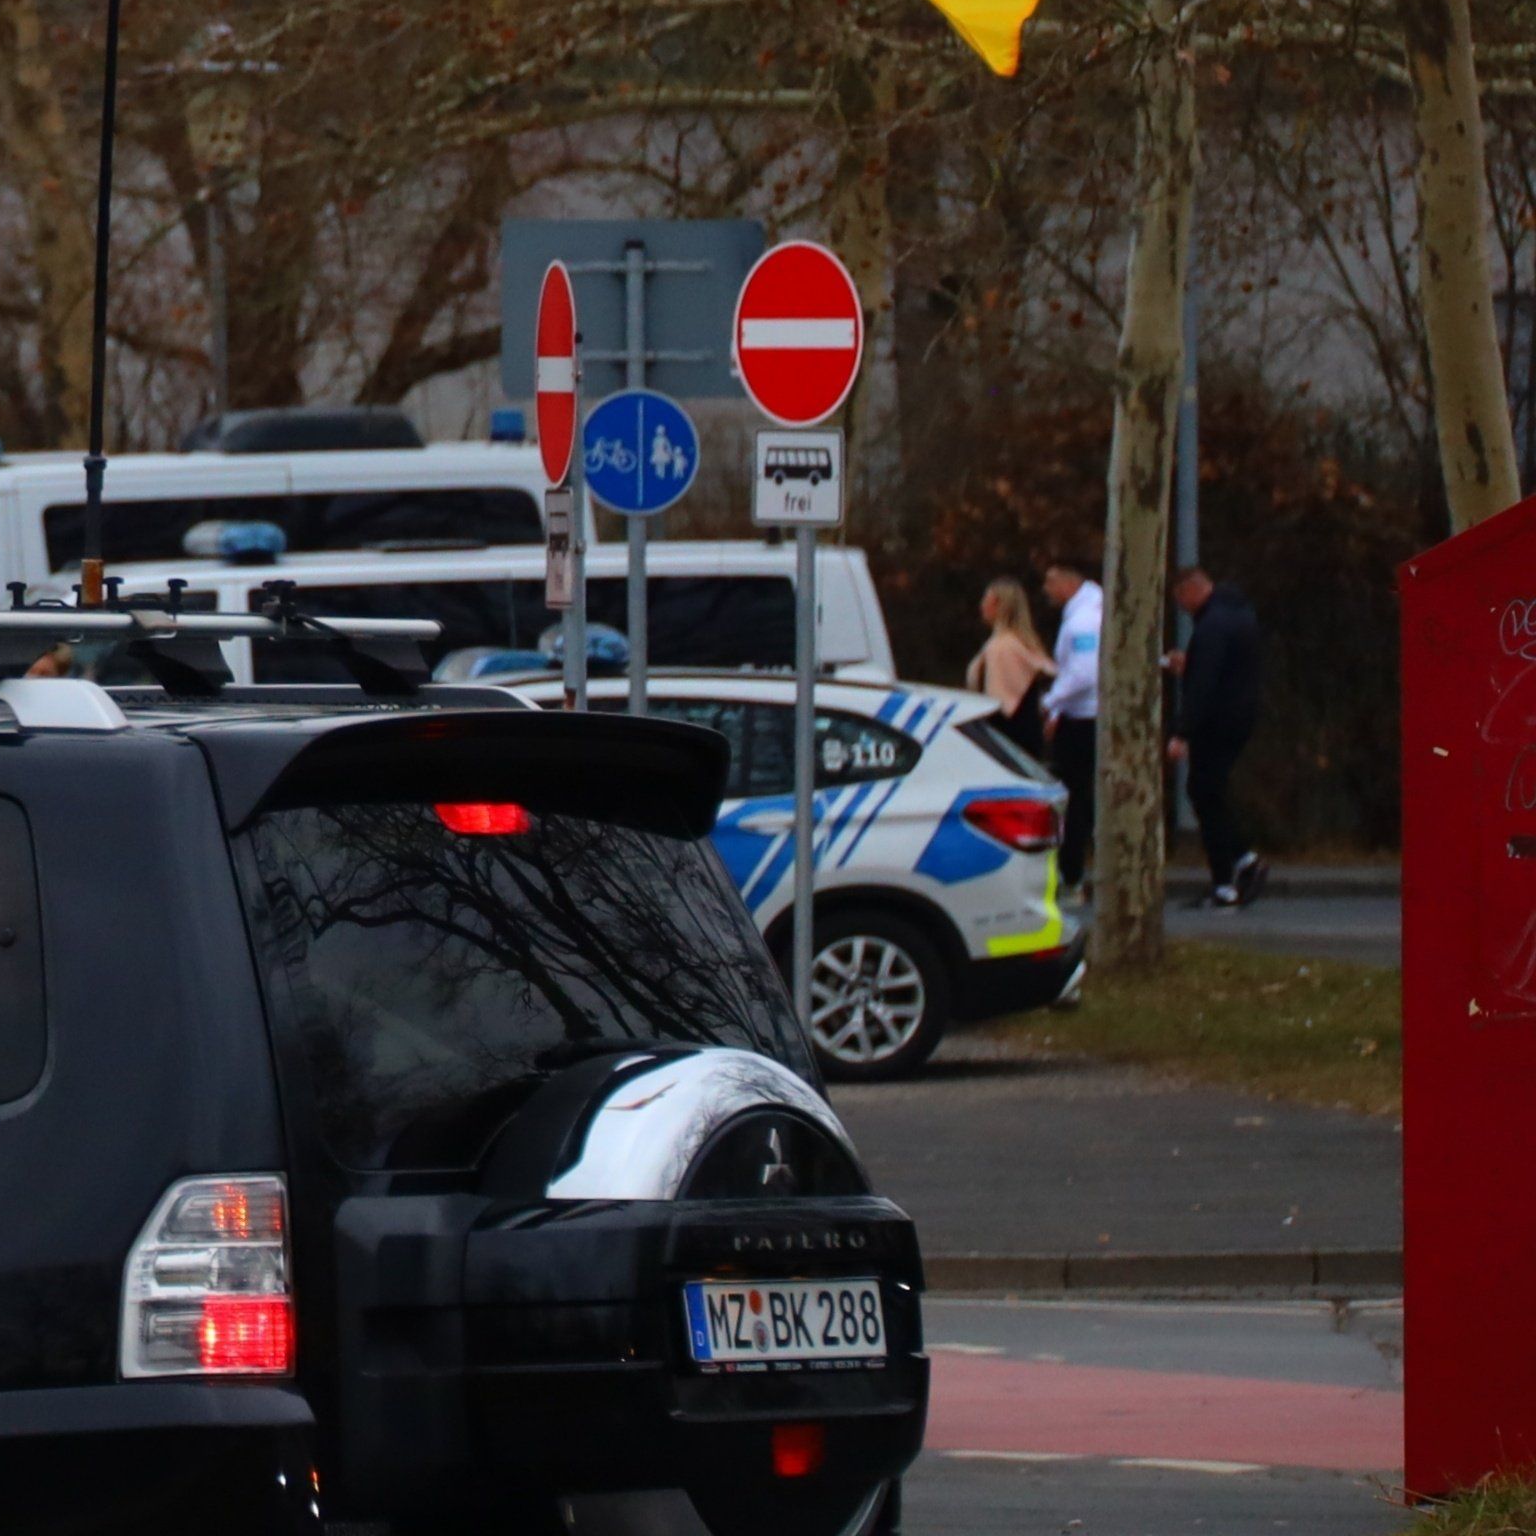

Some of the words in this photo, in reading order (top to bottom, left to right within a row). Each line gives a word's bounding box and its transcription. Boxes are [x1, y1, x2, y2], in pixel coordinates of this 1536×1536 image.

[784, 492, 812, 512] frei
[852, 737, 895, 767] 110
[707, 1293, 753, 1350] MZ
[770, 1291, 815, 1349] BK
[817, 1290, 881, 1346] 288
